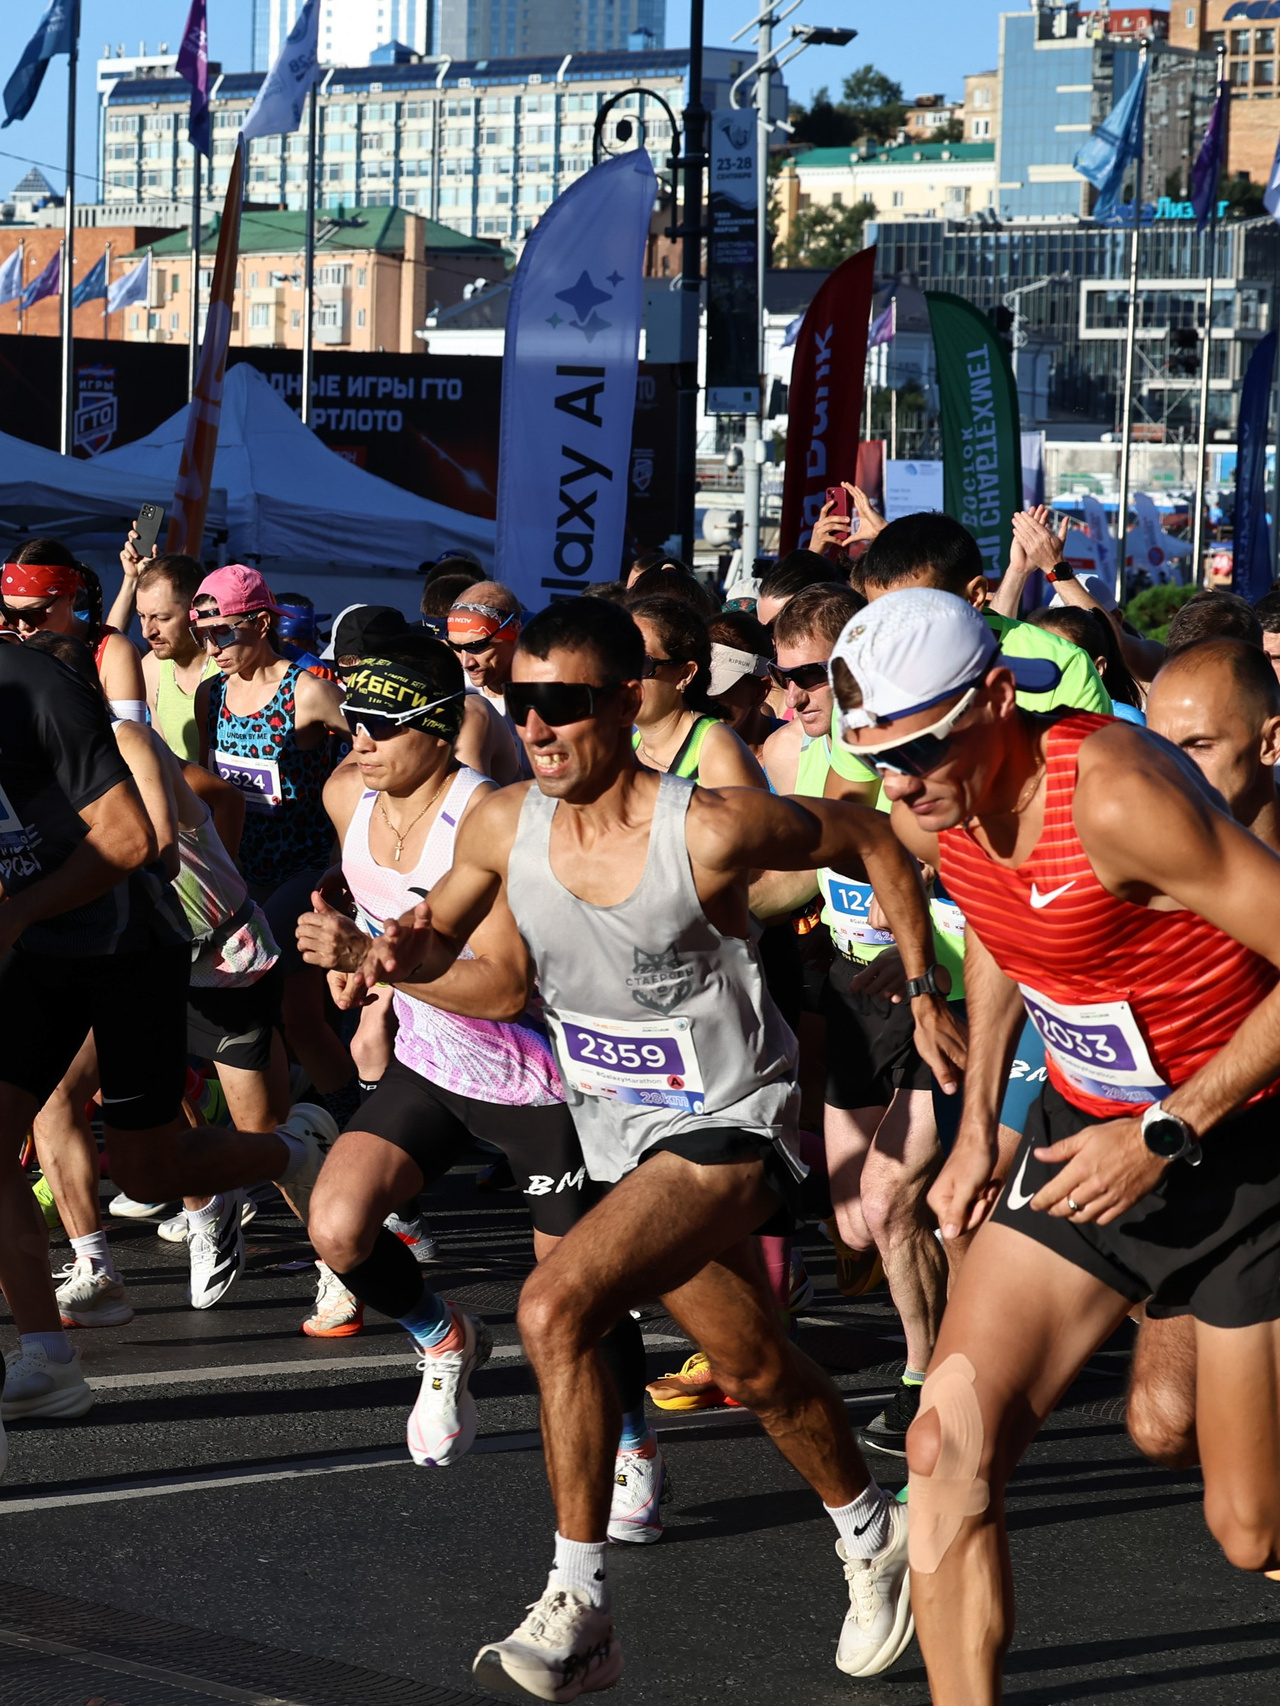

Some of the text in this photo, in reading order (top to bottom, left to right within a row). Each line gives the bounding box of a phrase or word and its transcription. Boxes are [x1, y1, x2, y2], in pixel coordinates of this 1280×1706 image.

[716, 156, 752, 170] 23-28
[1154, 196, 1230, 219] Лизг
[79, 380, 114, 390] ИГРЫ
[347, 376, 415, 399] ИГРЫ
[421, 378, 463, 400] ГТО
[80, 406, 112, 432] ГТО
[541, 365, 613, 604] laxy AI
[729, 658, 750, 667] KIPRUN
[367, 675, 428, 707] БЕГИ
[226, 731, 248, 740] UNDER
[248, 732, 256, 740] BY
[220, 767, 266, 790] 2324
[1034, 1009, 1117, 1063] 2033
[577, 1033, 666, 1068] 2359
[595, 1071, 662, 1085] #GalaxyMarathon
[670, 1077, 682, 1087] A
[639, 1091, 690, 1108] 28km
